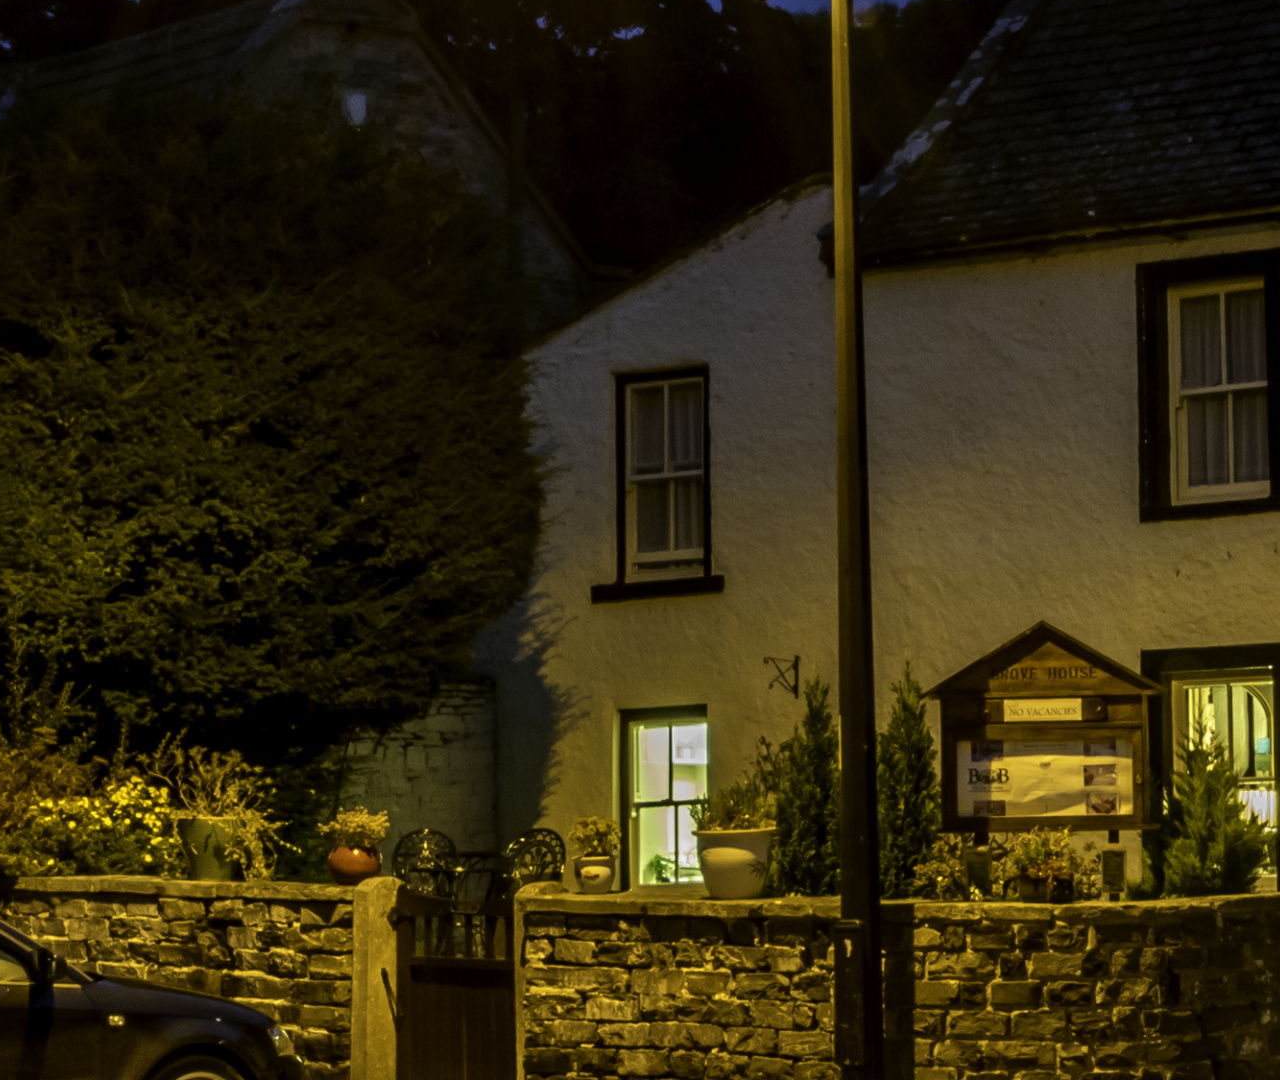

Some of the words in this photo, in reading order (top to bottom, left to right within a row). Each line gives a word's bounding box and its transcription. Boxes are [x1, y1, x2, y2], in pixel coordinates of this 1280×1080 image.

[1048, 666, 1098, 679] HOUSE
[1009, 708, 1024, 717] NO
[1026, 706, 1077, 716] VACANCIES
